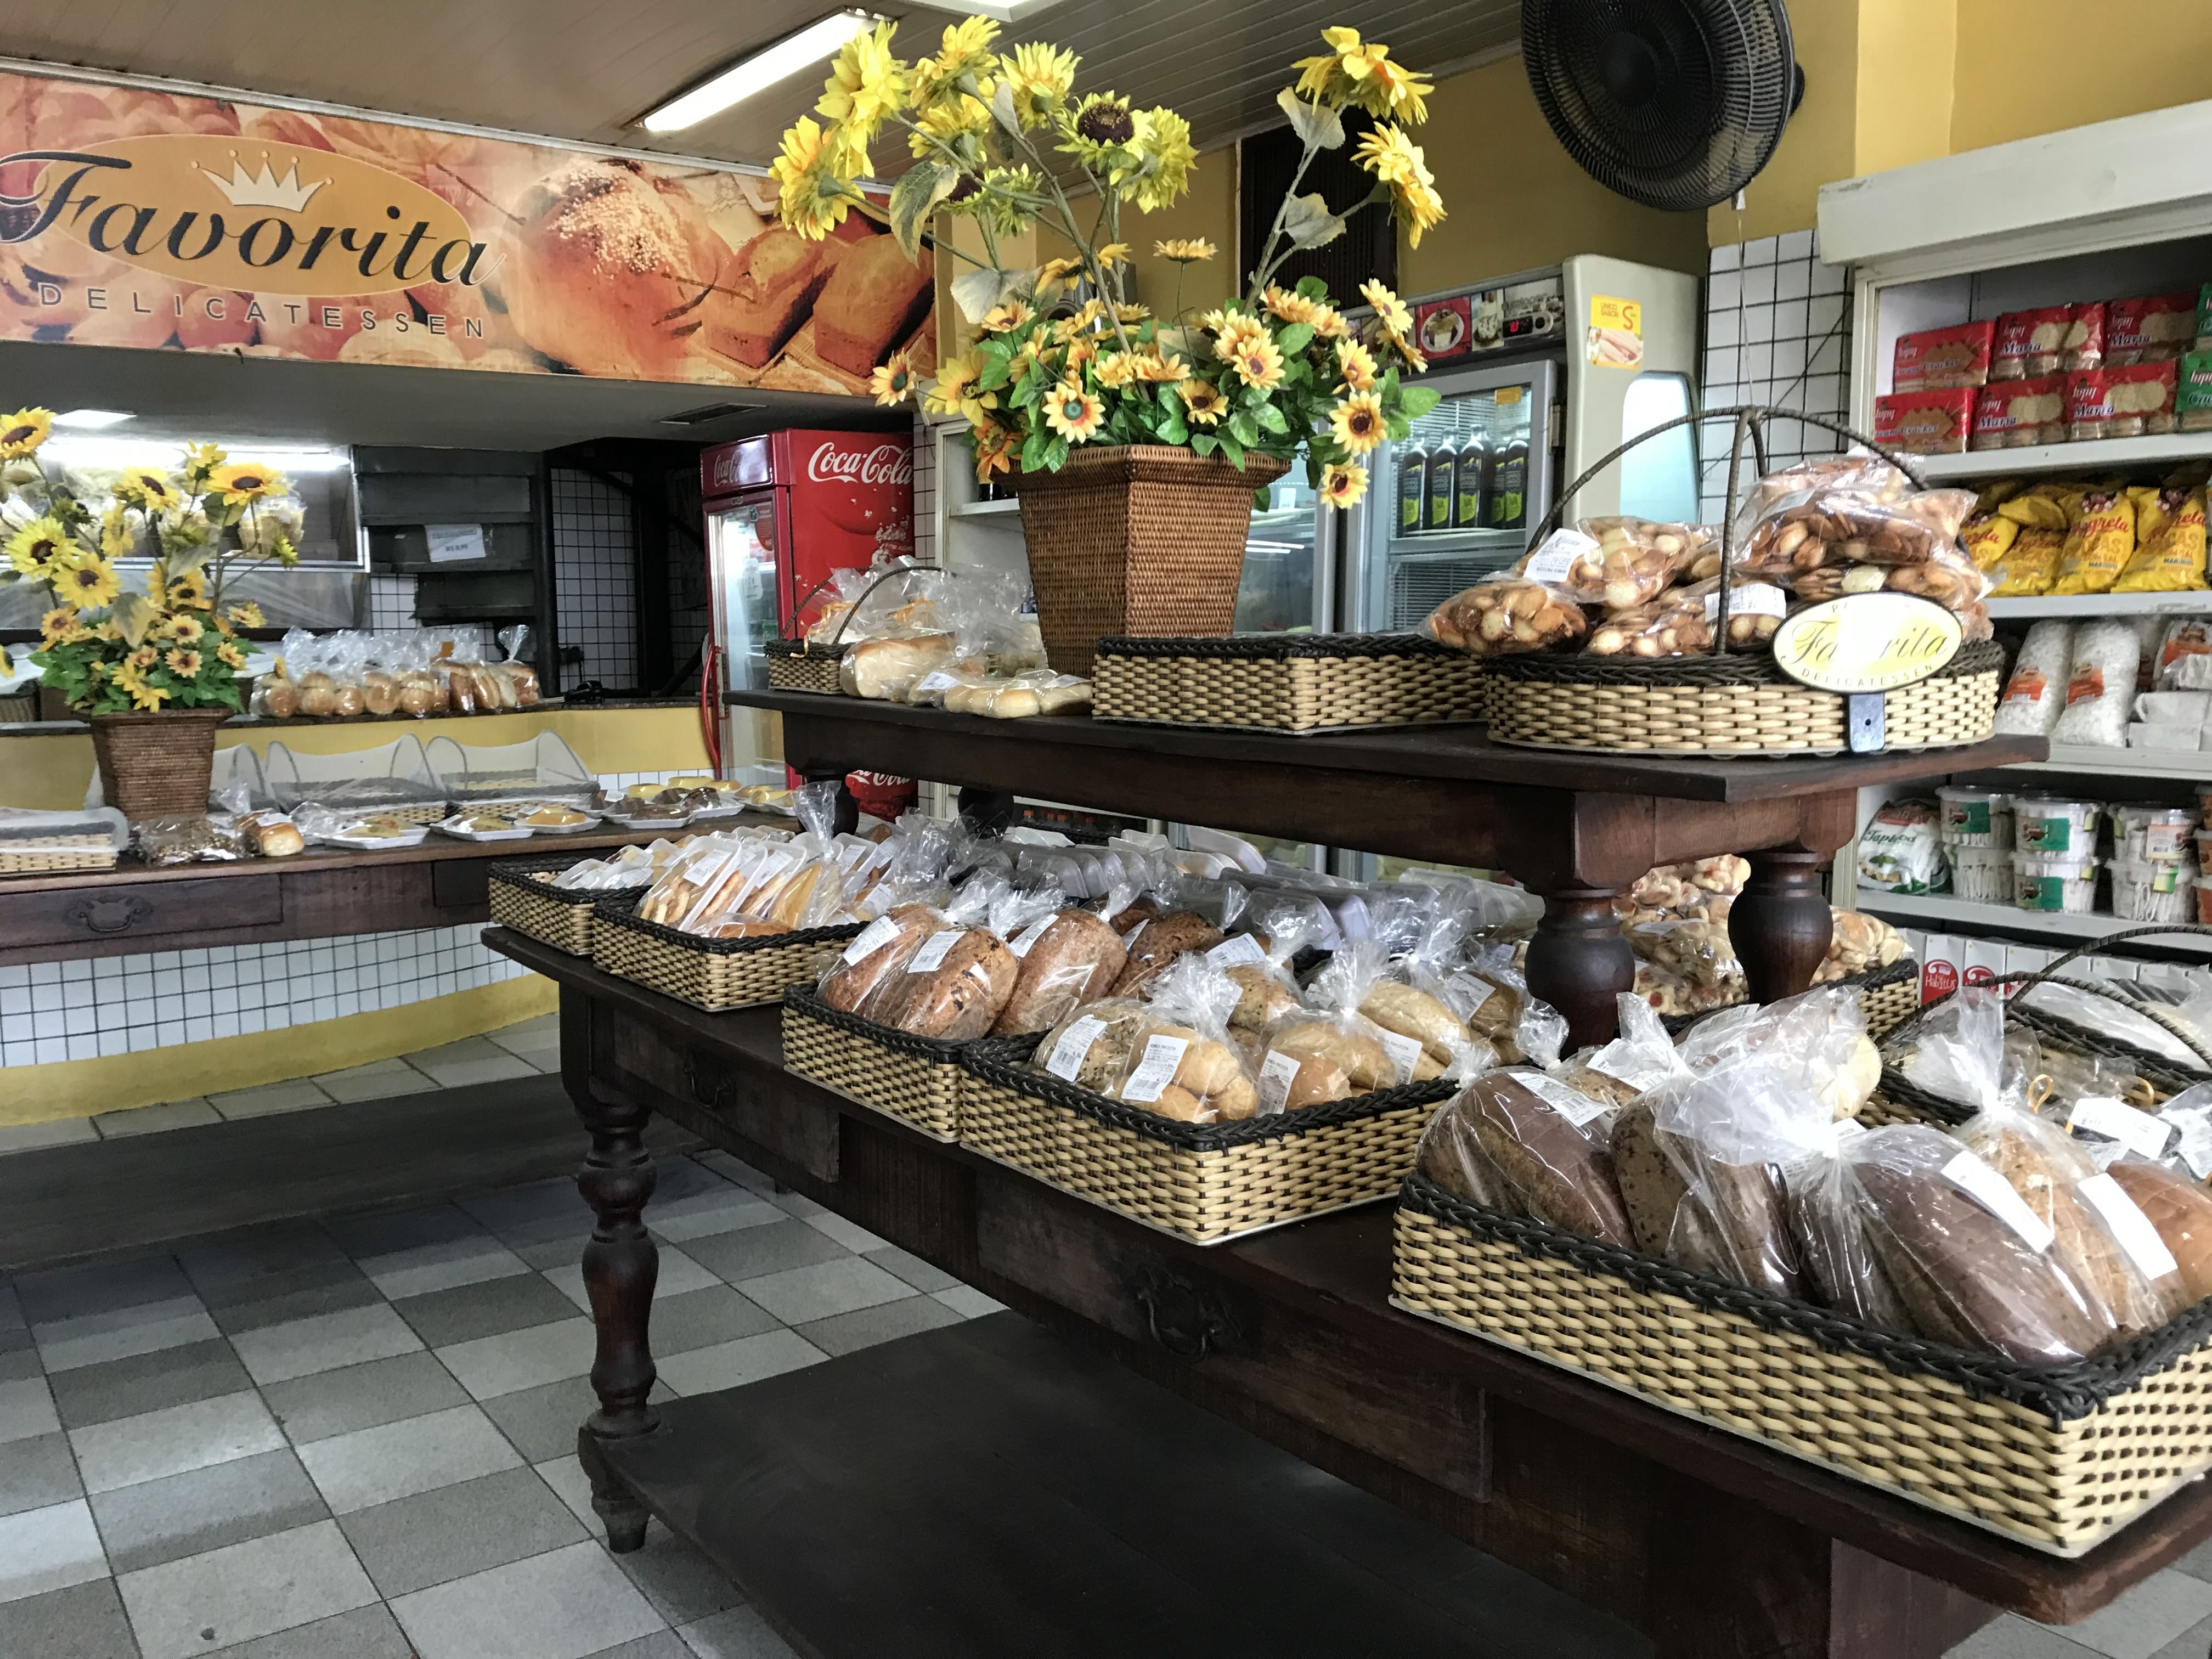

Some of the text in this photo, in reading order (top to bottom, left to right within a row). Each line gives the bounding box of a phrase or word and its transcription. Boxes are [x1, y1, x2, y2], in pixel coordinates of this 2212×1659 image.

[0, 150, 507, 287] Favorita
[38, 282, 484, 338] DELICATESSEN
[808, 442, 913, 485] Coca-Cola
[1780, 620, 1949, 665] Farita
[1802, 663, 1933, 686] DELICATESSEN
